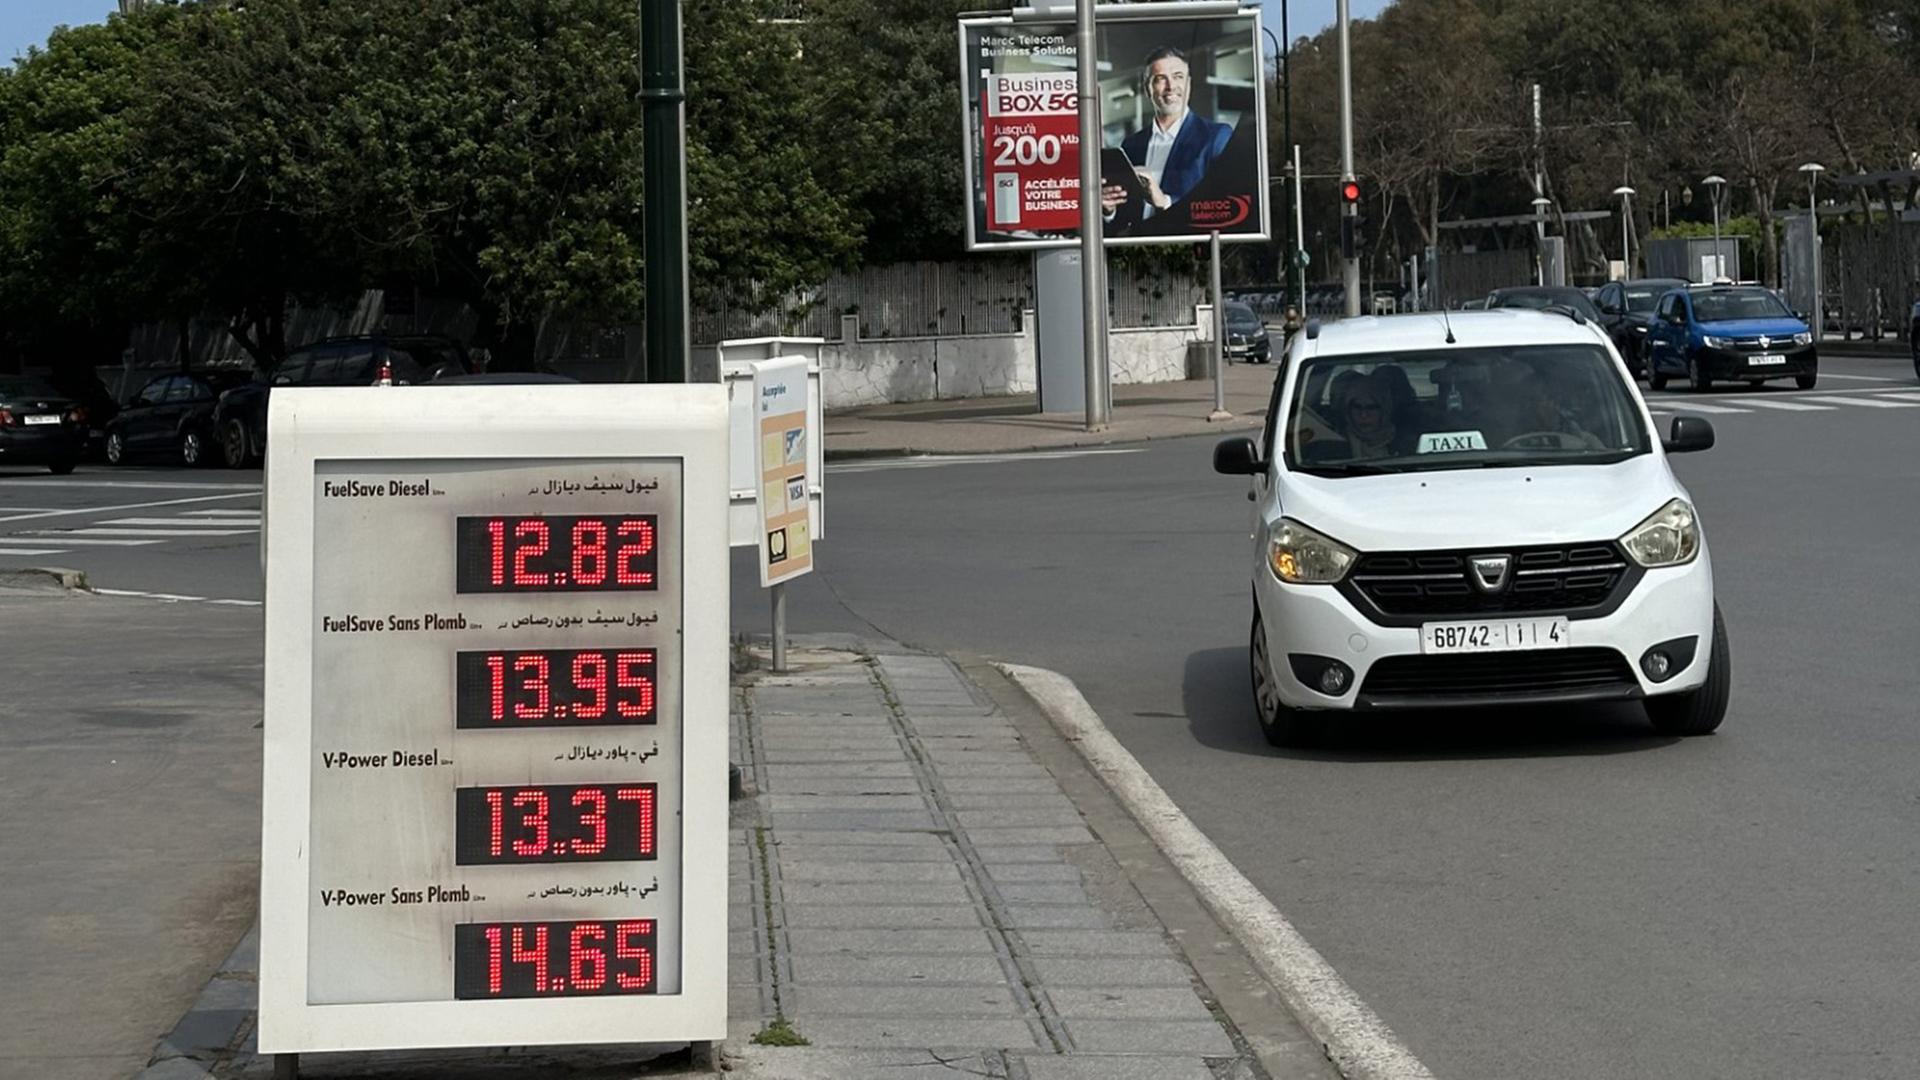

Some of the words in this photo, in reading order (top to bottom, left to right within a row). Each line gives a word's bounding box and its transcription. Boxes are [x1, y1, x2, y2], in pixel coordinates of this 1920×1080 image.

[981, 36, 1015, 46] Maroc
[1019, 34, 1064, 45] Telecom
[981, 47, 1030, 57] Business
[998, 77, 1077, 93] Busines
[999, 94, 1045, 112] BOX
[1048, 93, 1078, 110] 5G
[994, 123, 1036, 137] Jusqu'à
[994, 134, 1061, 166] 200
[1025, 190, 1062, 200] VOTRE
[1025, 200, 1079, 211] BUSINESS
[1190, 200, 1231, 210] maroc
[1429, 436, 1473, 451] TAXI
[324, 480, 385, 497] FuelSave
[389, 478, 429, 497] Diesel
[625, 477, 659, 494] فيول
[788, 484, 804, 501] VISA
[488, 520, 653, 585] 12.82
[323, 615, 384, 632] FuelSave
[388, 614, 420, 631] Sans
[424, 612, 467, 630] Plomb
[512, 613, 553, 629] رصاص
[626, 610, 659, 627] فيول
[1434, 625, 1490, 648] 68742
[1549, 621, 1560, 643] 4
[487, 653, 653, 720] 13.95
[323, 751, 388, 769] V-Power
[392, 748, 438, 767] Diesel
[487, 788, 653, 856] 13.37
[321, 889, 386, 906] V-Power
[391, 887, 424, 904] Sans
[428, 884, 470, 902] Plomb
[486, 921, 652, 993] 14.65
